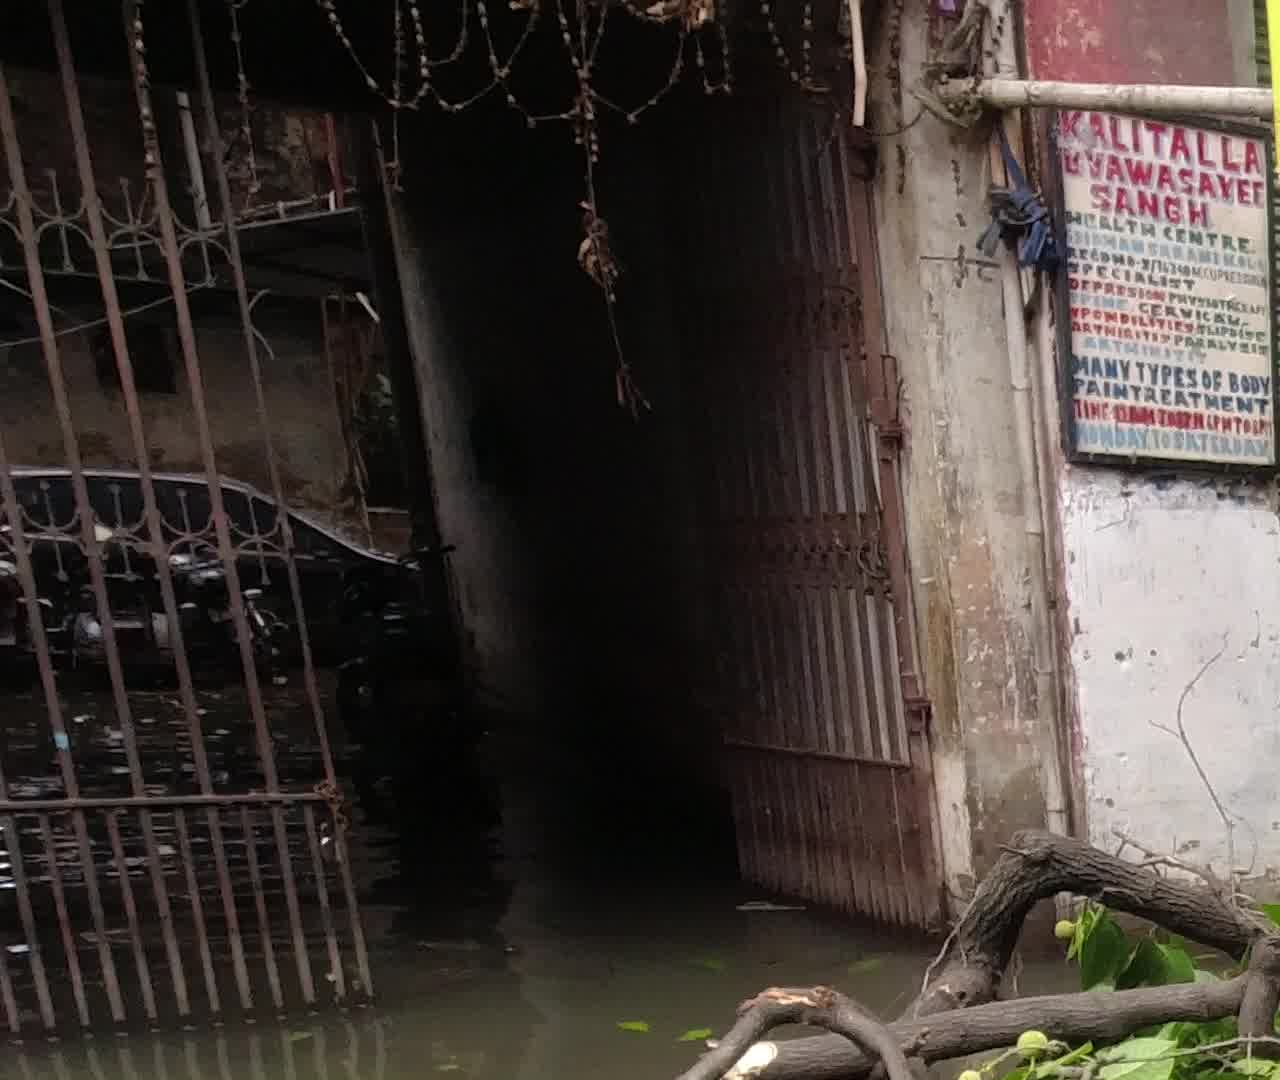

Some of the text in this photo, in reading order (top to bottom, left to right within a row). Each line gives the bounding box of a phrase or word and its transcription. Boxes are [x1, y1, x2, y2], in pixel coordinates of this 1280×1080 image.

[1058, 111, 1261, 174] KALITALLA
[1090, 184, 1209, 227] SANGH
[1163, 225, 1251, 254] CENTRE
[1067, 262, 1196, 291] SPECIALIST
[1070, 354, 1270, 396] MANY TYPES OF BODY
